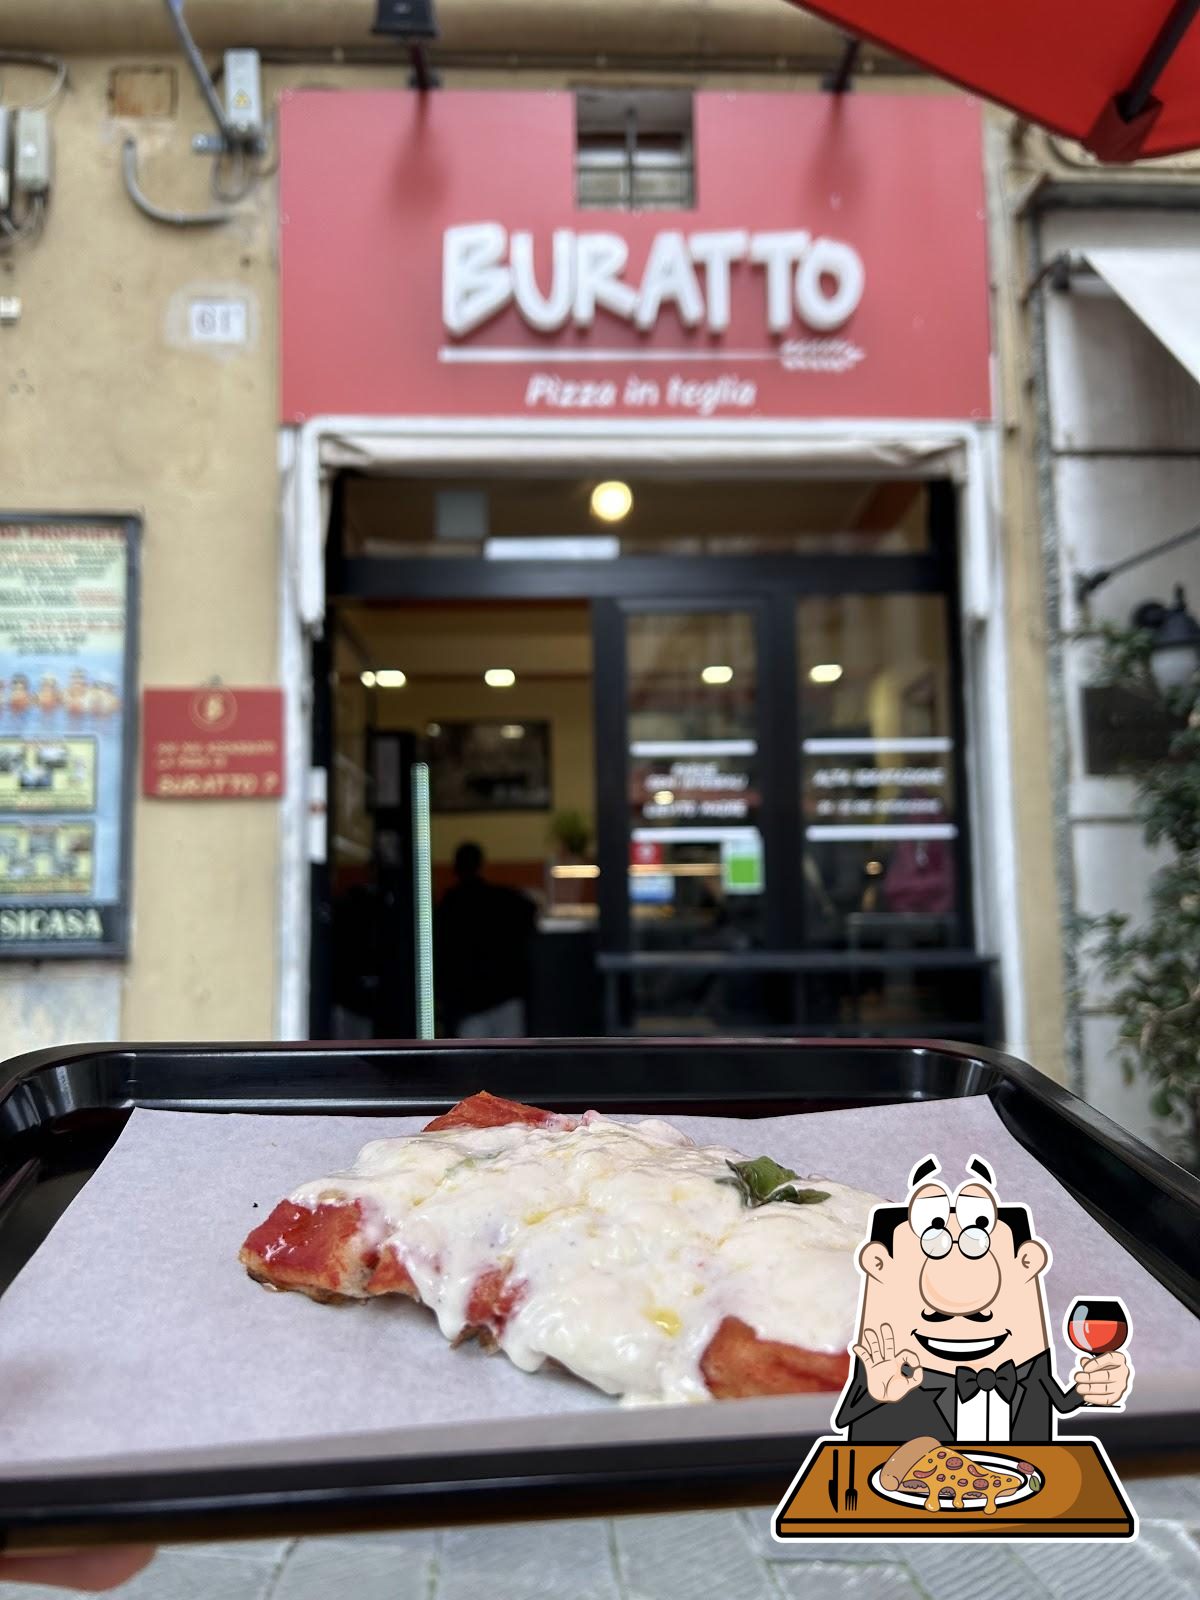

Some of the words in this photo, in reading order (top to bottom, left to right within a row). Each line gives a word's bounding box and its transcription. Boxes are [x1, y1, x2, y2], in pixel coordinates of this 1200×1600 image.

[441, 222, 866, 338] BURATTO
[525, 374, 617, 408] Pizza
[624, 374, 660, 407] in
[667, 374, 757, 416] teglia
